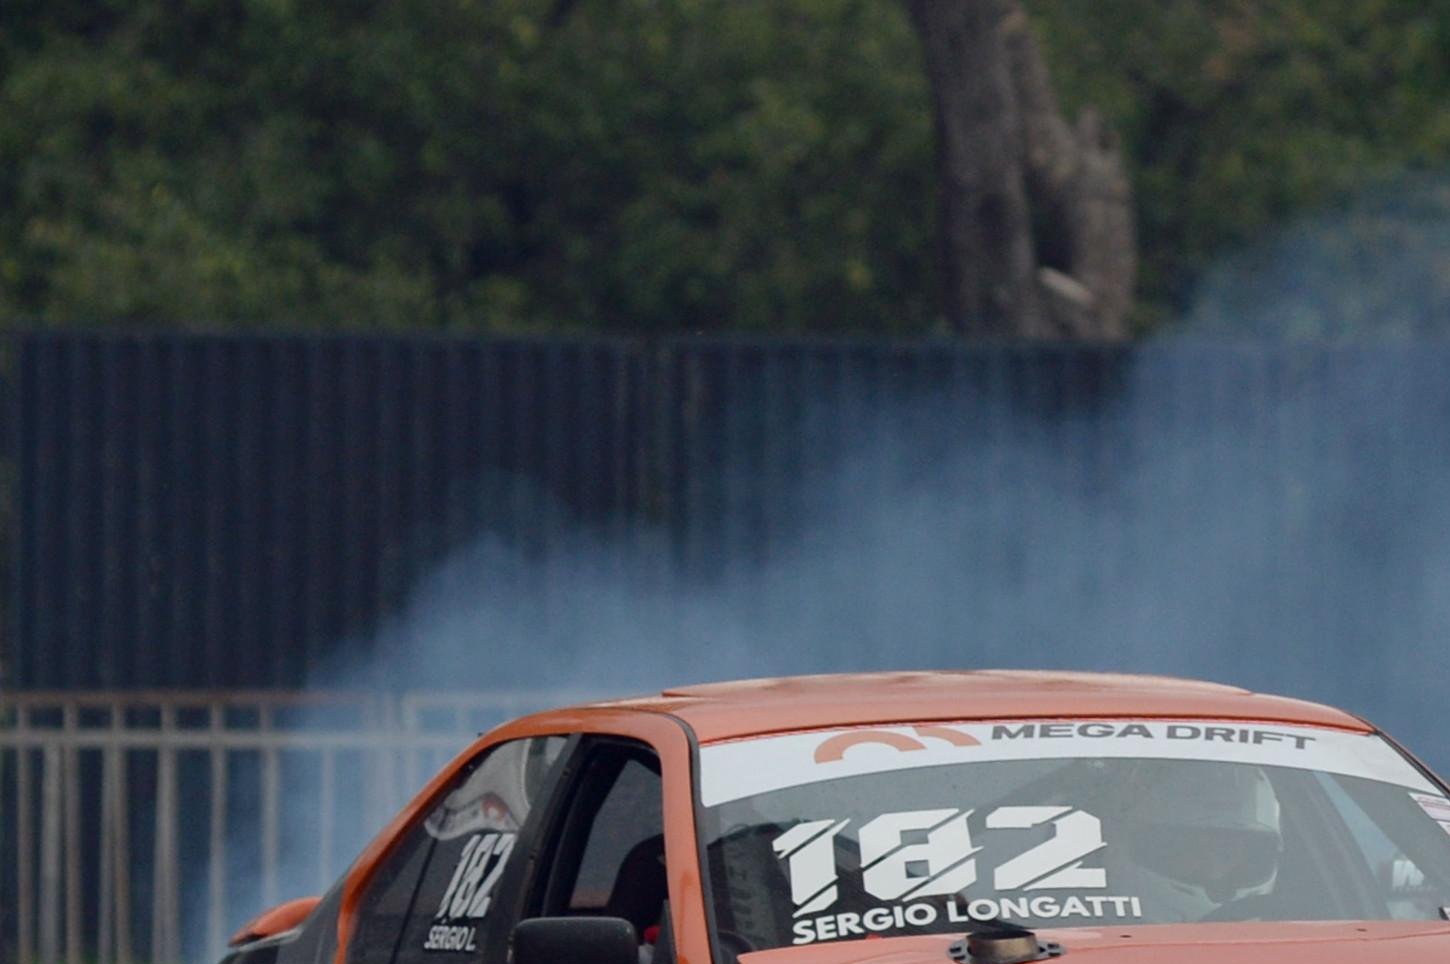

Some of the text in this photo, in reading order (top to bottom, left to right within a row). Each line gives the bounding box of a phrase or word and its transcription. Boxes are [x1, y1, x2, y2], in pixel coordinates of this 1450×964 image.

[991, 723, 1316, 750] MEGA DRIFT
[434, 832, 517, 919] 182
[772, 805, 1108, 919] 182
[792, 895, 1143, 946] SERGIO LONGATTI
